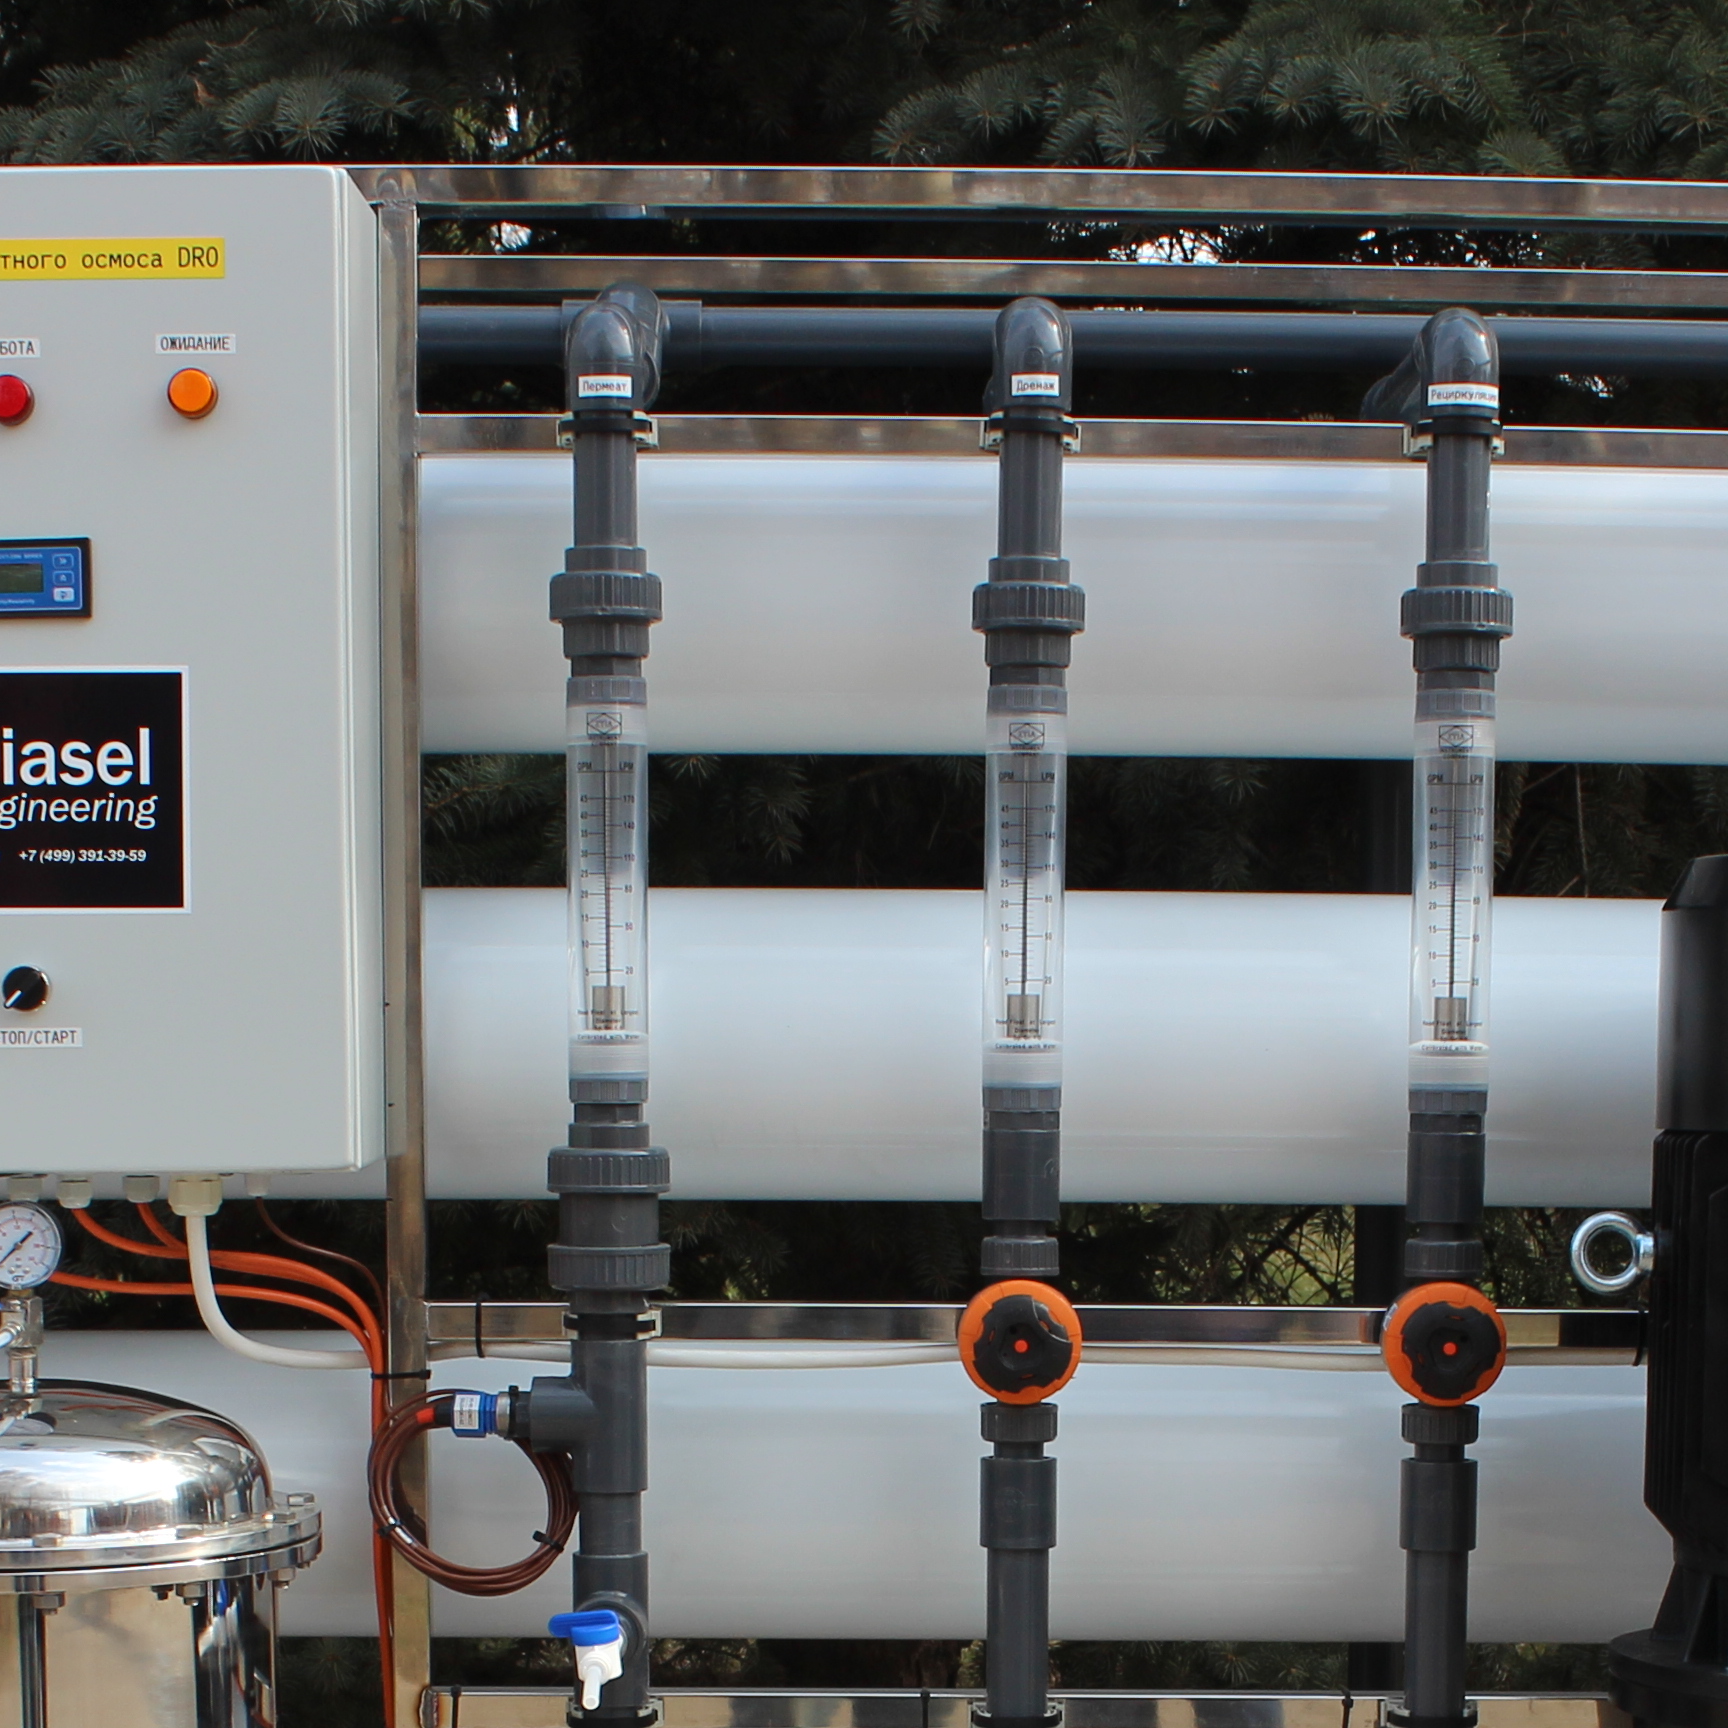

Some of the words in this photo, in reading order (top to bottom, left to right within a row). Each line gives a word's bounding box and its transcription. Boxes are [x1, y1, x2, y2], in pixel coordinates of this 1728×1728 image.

[81, 248, 163, 270] осмоса
[178, 246, 220, 269] DRO
[160, 335, 231, 353] ОЖИДАНИЕ
[583, 380, 626, 392] Пермеат
[1017, 380, 1055, 392] Дренаж
[620, 762, 633, 770] LPM
[1042, 772, 1054, 780] LPM
[1470, 775, 1483, 783] LPM
[18, 848, 37, 863] +7
[40, 847, 76, 865] (499)
[78, 848, 147, 863] 391-39-59
[581, 890, 588, 898] 20
[1000, 900, 1008, 908] 20
[1428, 902, 1436, 910] 20
[581, 914, 588, 922] 15
[1001, 923, 1008, 931] 15
